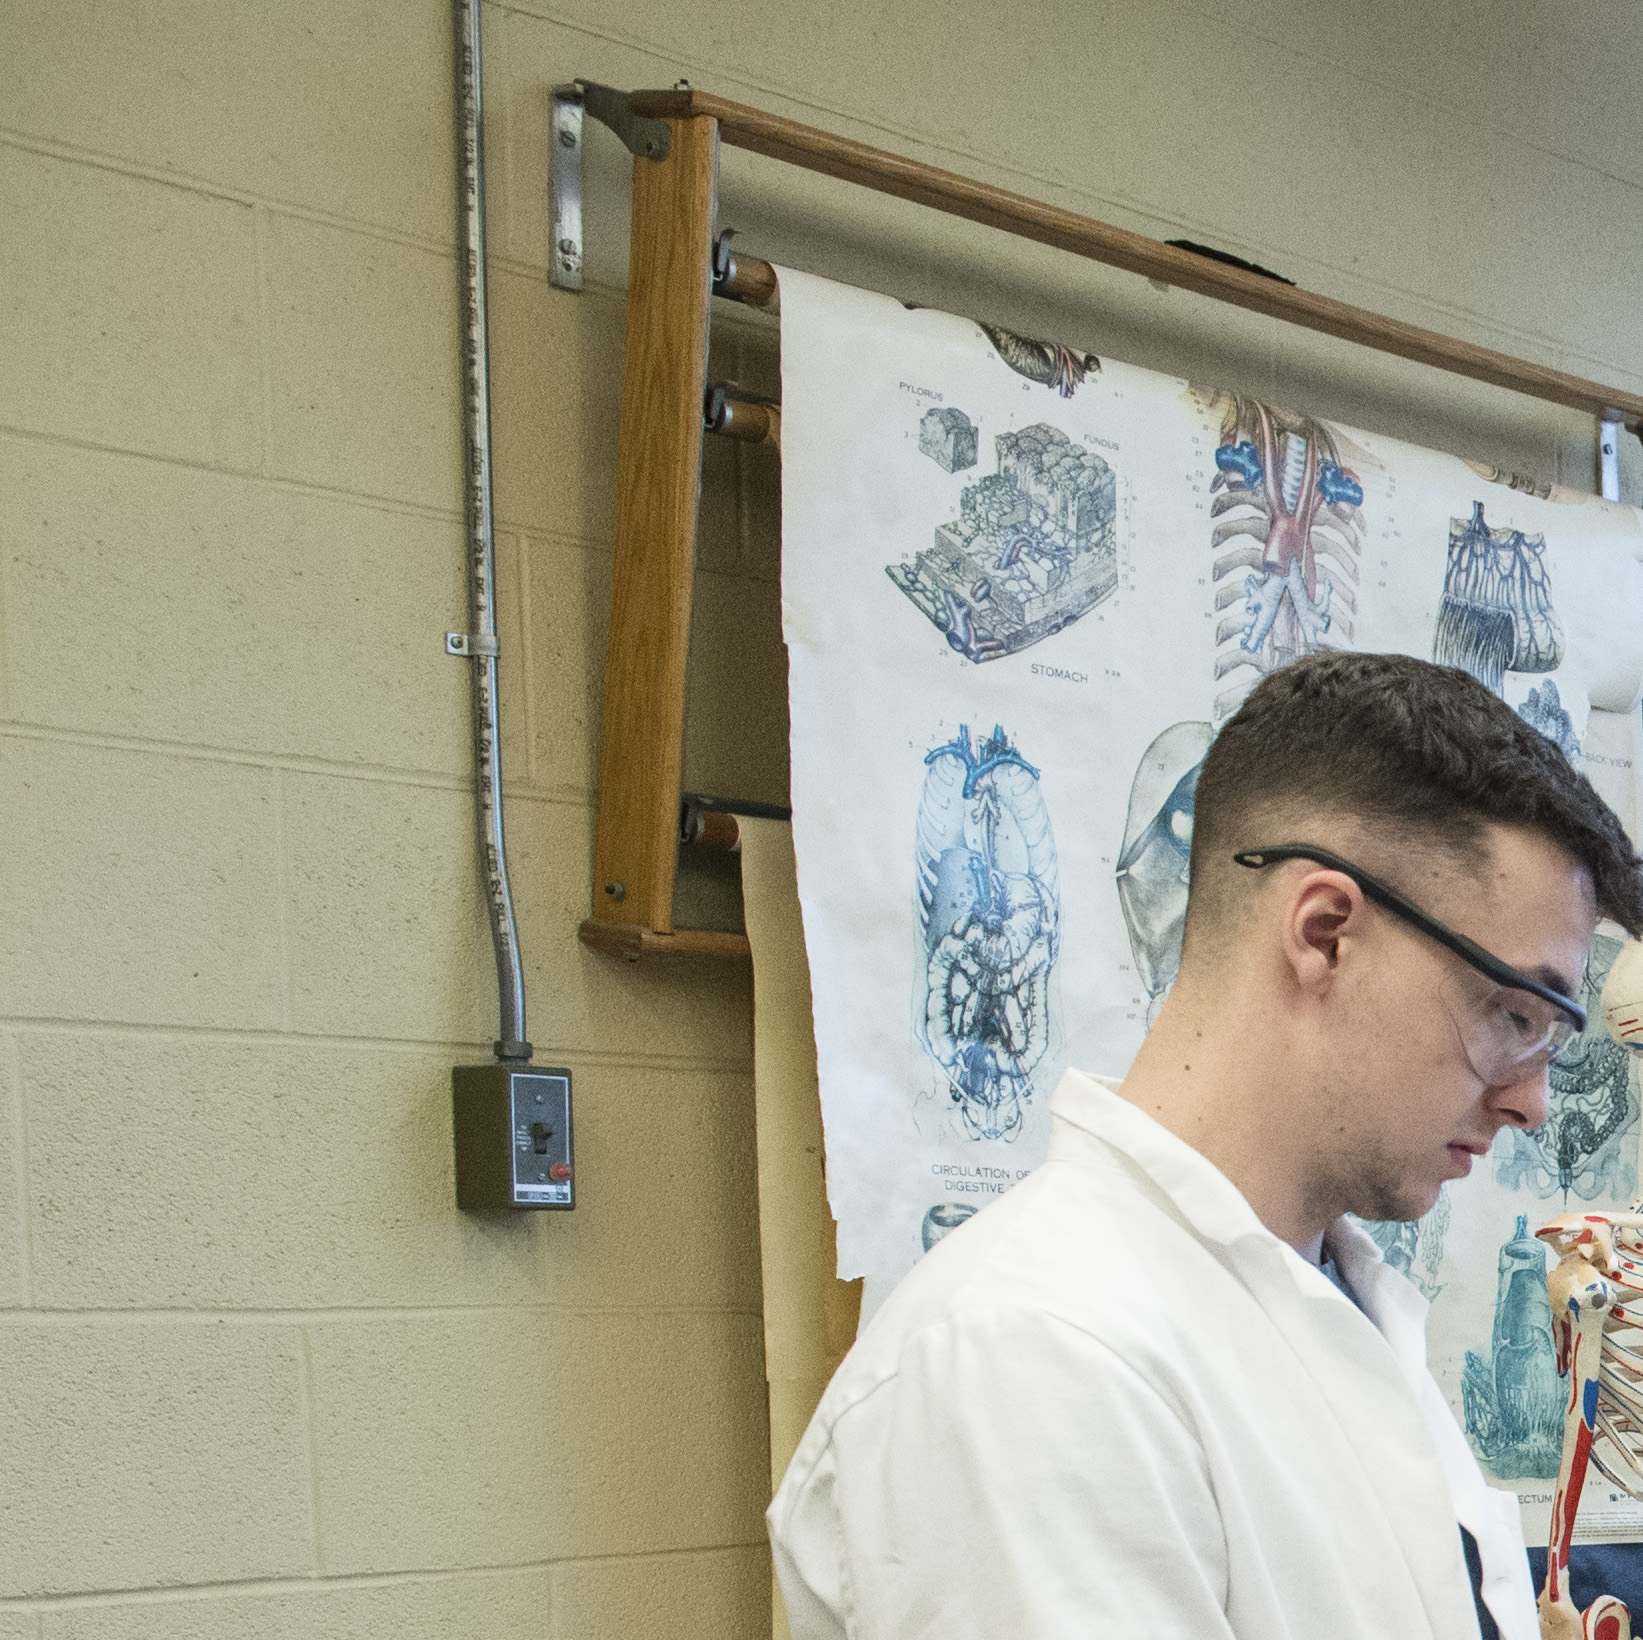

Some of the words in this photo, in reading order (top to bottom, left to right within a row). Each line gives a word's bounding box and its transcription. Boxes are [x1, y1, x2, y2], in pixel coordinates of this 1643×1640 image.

[899, 381, 944, 402] PYLORUS
[1083, 433, 1120, 451] FUNDUS
[1031, 663, 1088, 684] STOMACH
[1585, 752, 1607, 765] BACK
[1609, 757, 1633, 769] VIEW
[931, 1163, 1011, 1180] CIRCULATION
[944, 1180, 1006, 1194] DIGESTIVE
[1518, 1494, 1553, 1504] ECTUM
